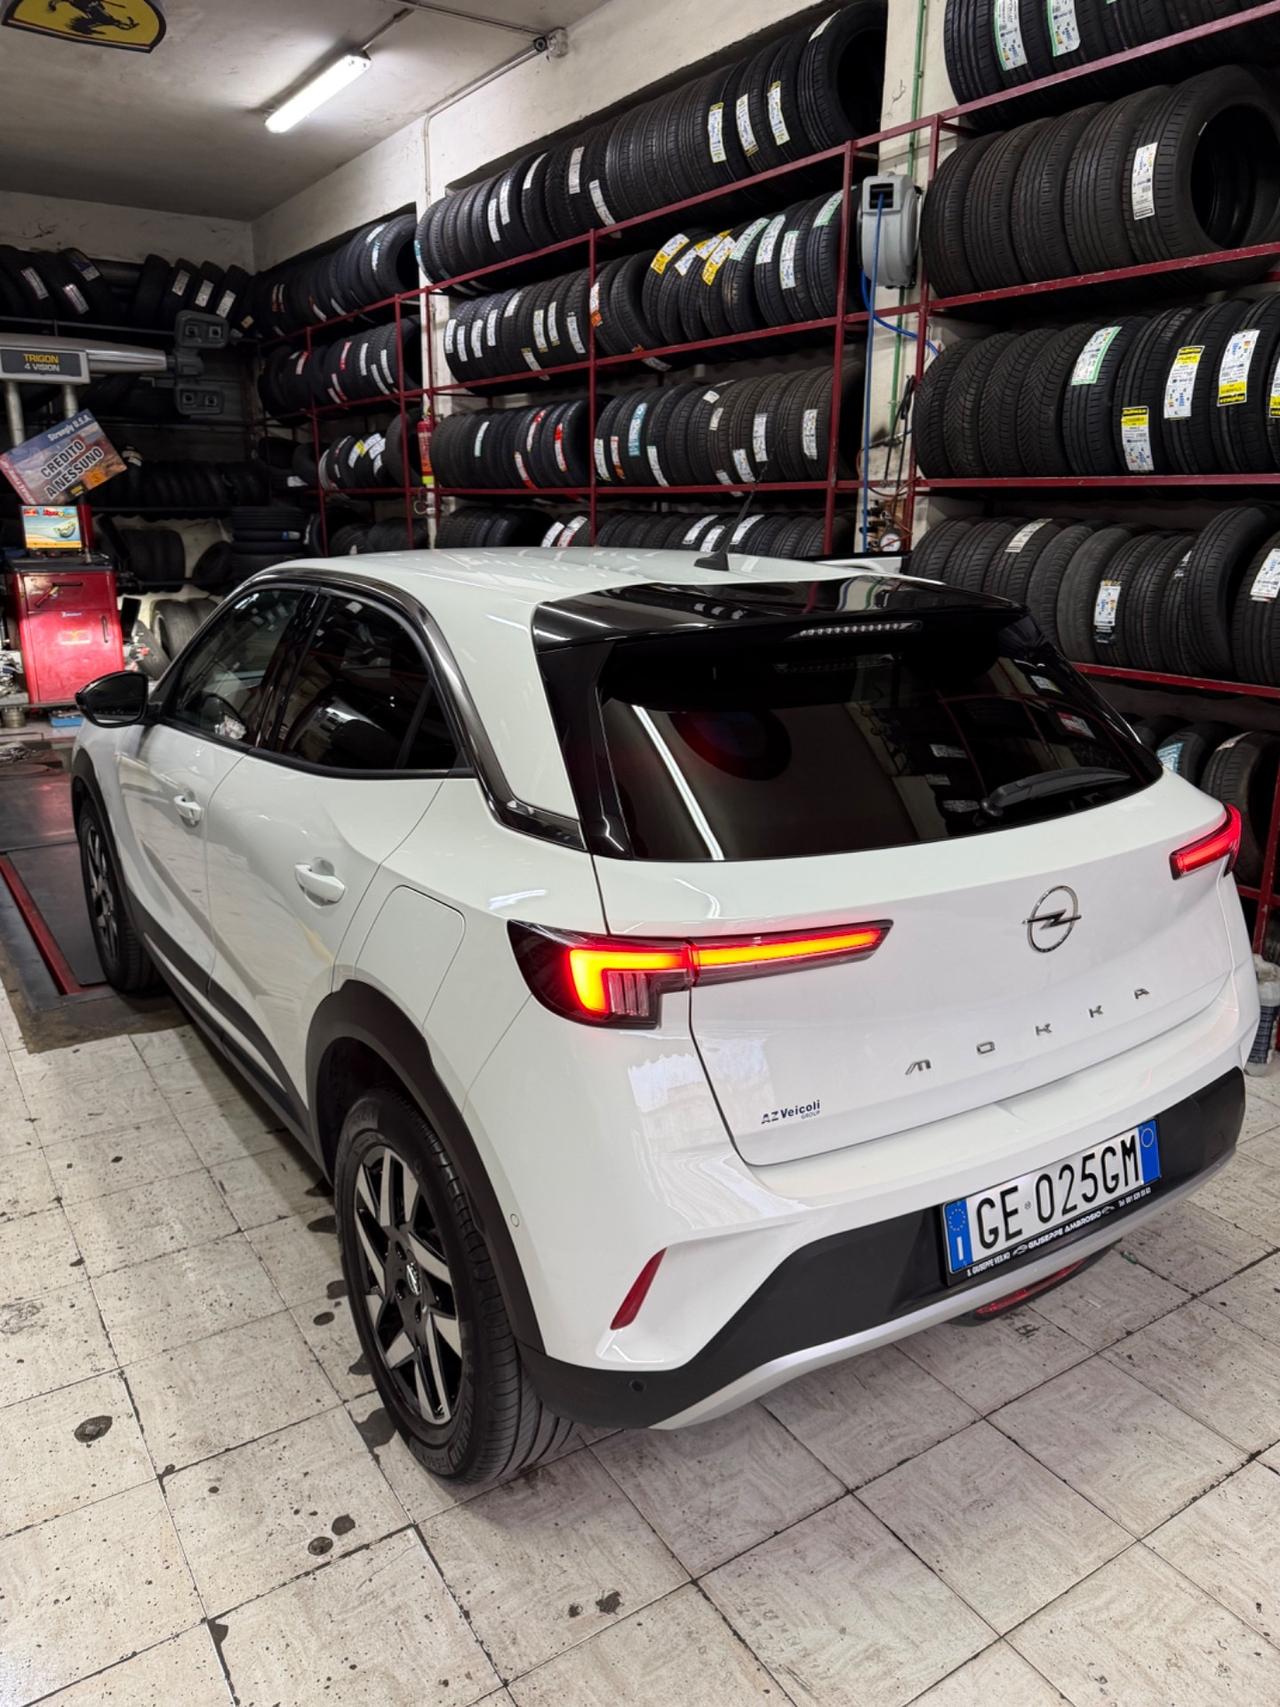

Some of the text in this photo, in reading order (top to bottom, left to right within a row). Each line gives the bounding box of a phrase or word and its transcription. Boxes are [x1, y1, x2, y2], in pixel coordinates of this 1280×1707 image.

[23, 353, 59, 363] TRIGON
[32, 363, 60, 372] VISION
[41, 440, 85, 478] CREDITO
[46, 486, 57, 498] A
[54, 448, 103, 490] NESSUNO
[780, 1099, 820, 1118] Veicoli
[976, 1134, 1140, 1249] GE 025GM
[1028, 1211, 1102, 1249] GIUSEPPE AMBROSIO
